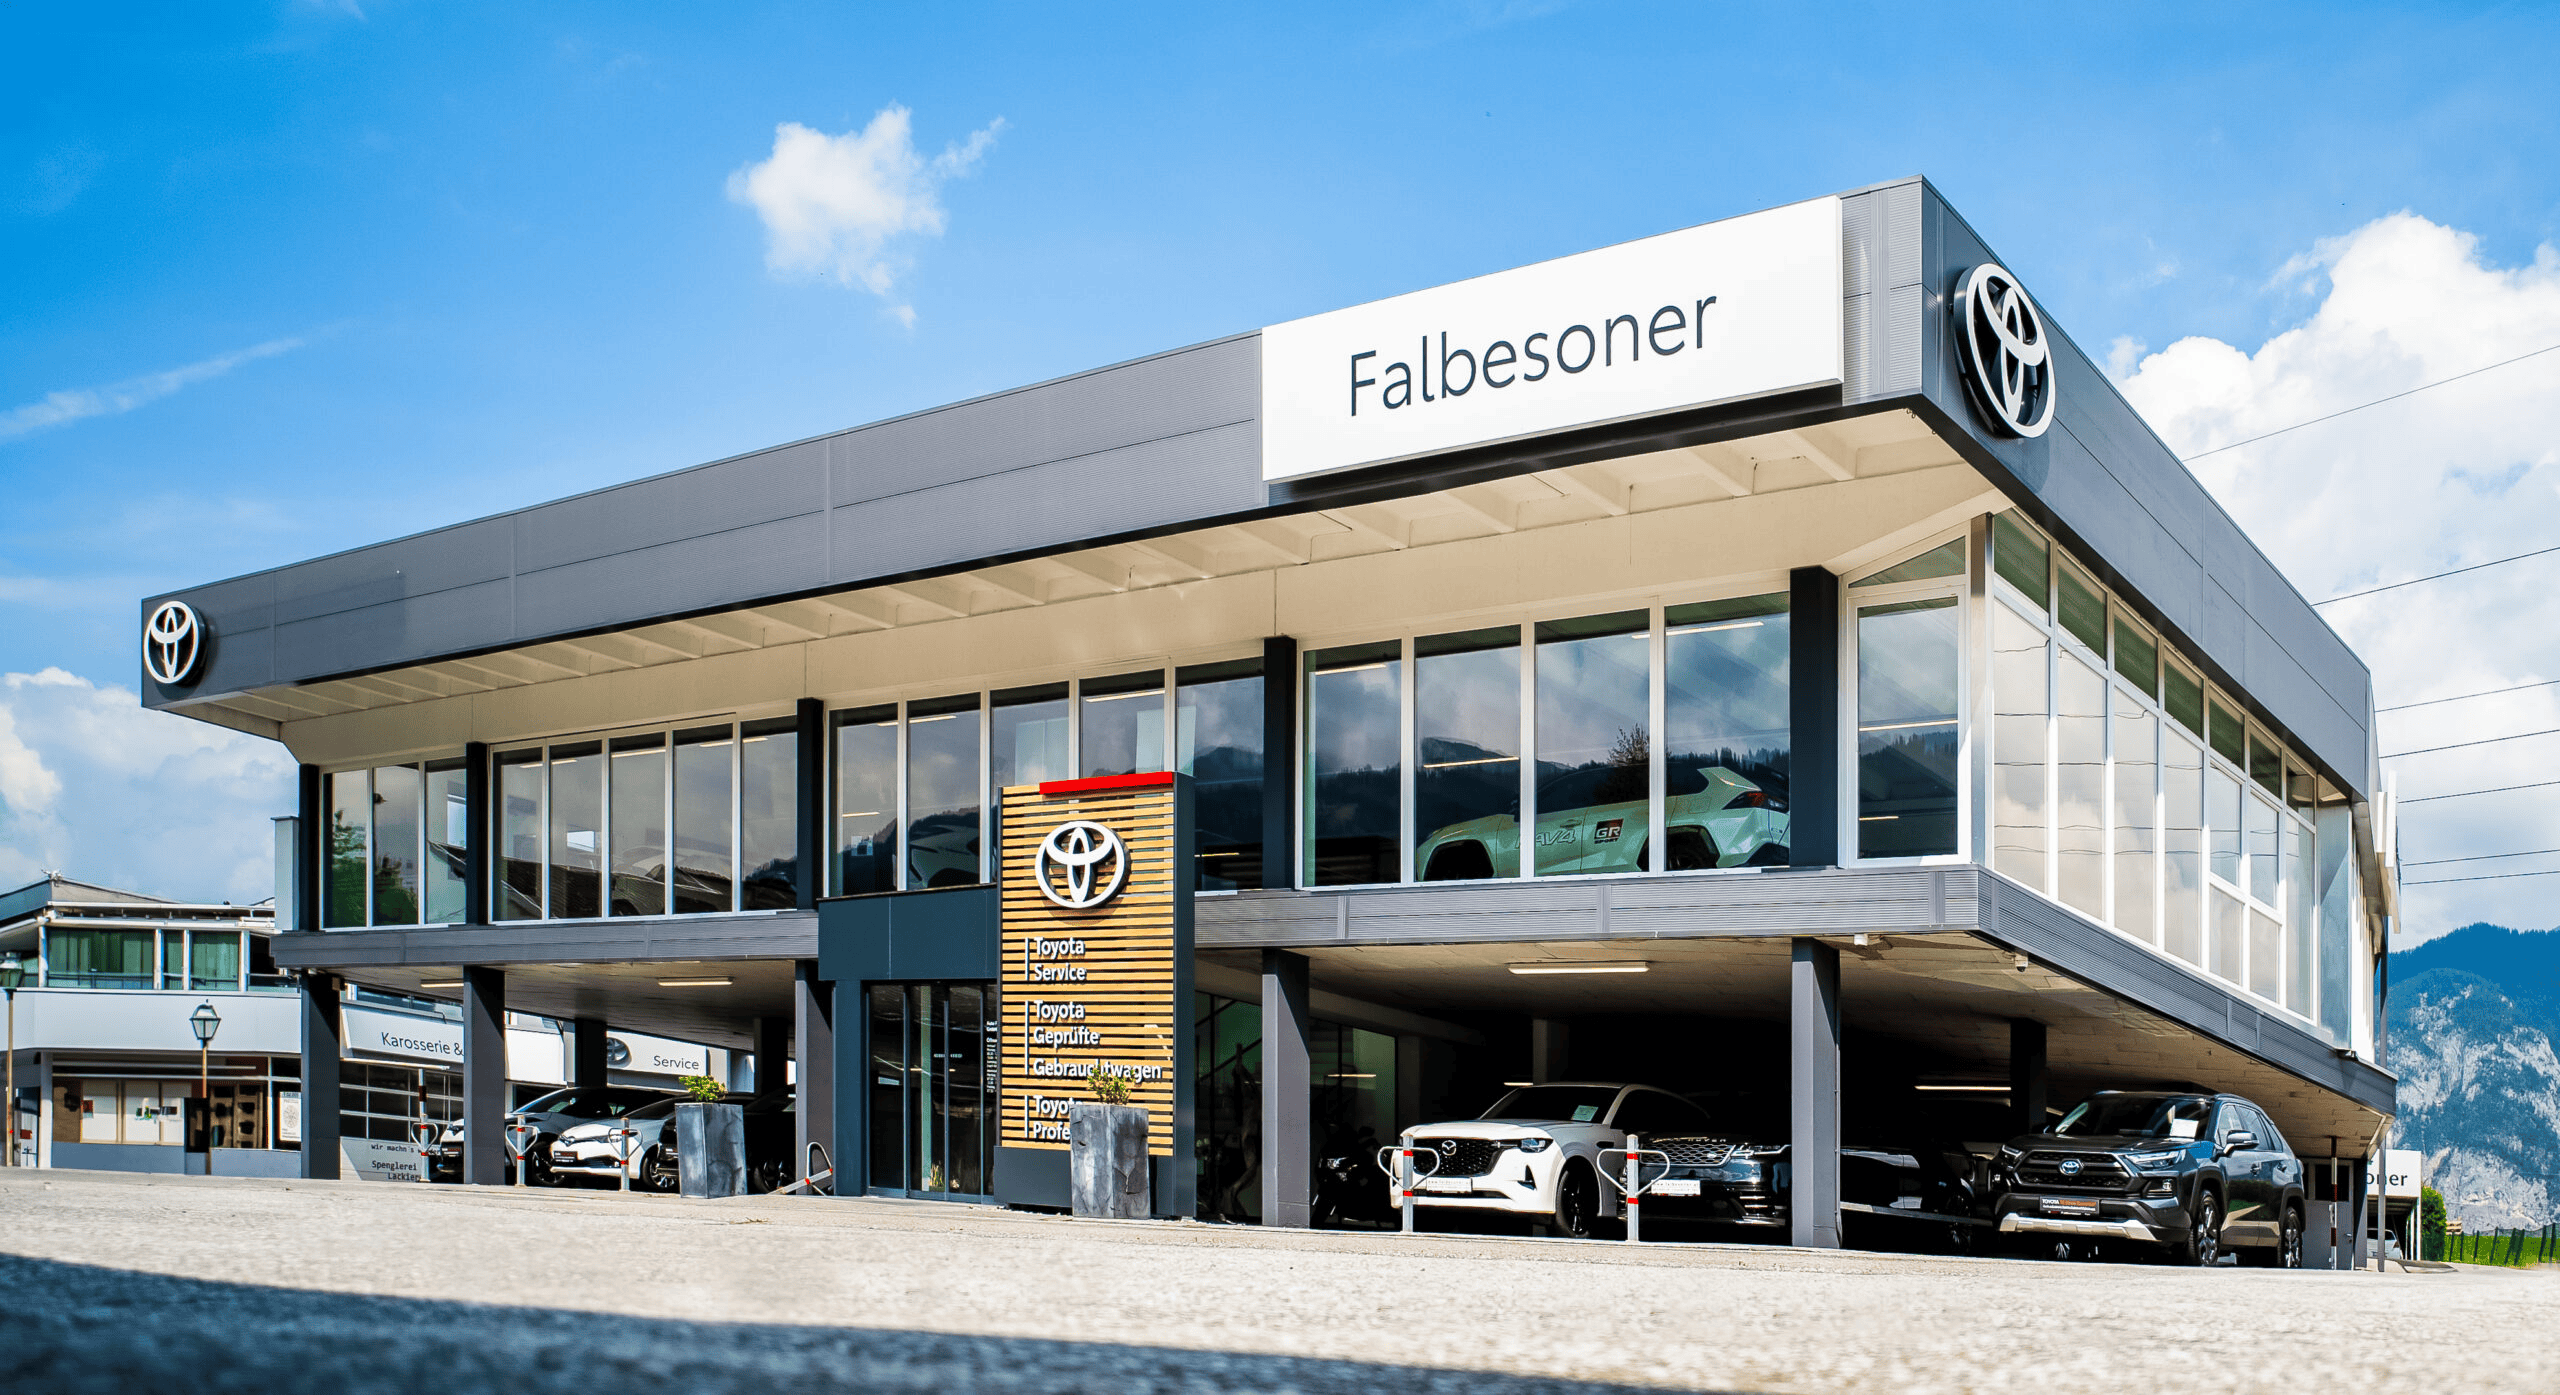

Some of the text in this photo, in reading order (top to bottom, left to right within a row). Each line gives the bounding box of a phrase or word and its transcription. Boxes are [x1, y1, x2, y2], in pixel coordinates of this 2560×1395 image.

[1351, 295, 1717, 416] Falbesoner
[1515, 828, 1576, 850] AV4
[1596, 826, 1621, 838] GR
[1033, 936, 1085, 959] Toyota
[1033, 963, 1087, 981] Service
[1033, 1000, 1085, 1023] Toyota
[381, 1032, 464, 1056] Karosserie &
[1033, 1026, 1100, 1048] Geprüfte
[653, 1055, 700, 1070] Service
[1033, 1058, 1163, 1084] Gebrauchtwagen
[1033, 1095, 1083, 1119] Toyo
[1033, 1121, 1071, 1140] Profe
[372, 1160, 417, 1171] Spenglerei
[388, 1172, 421, 1181] Lackier
[2367, 1173, 2408, 1186] oner
